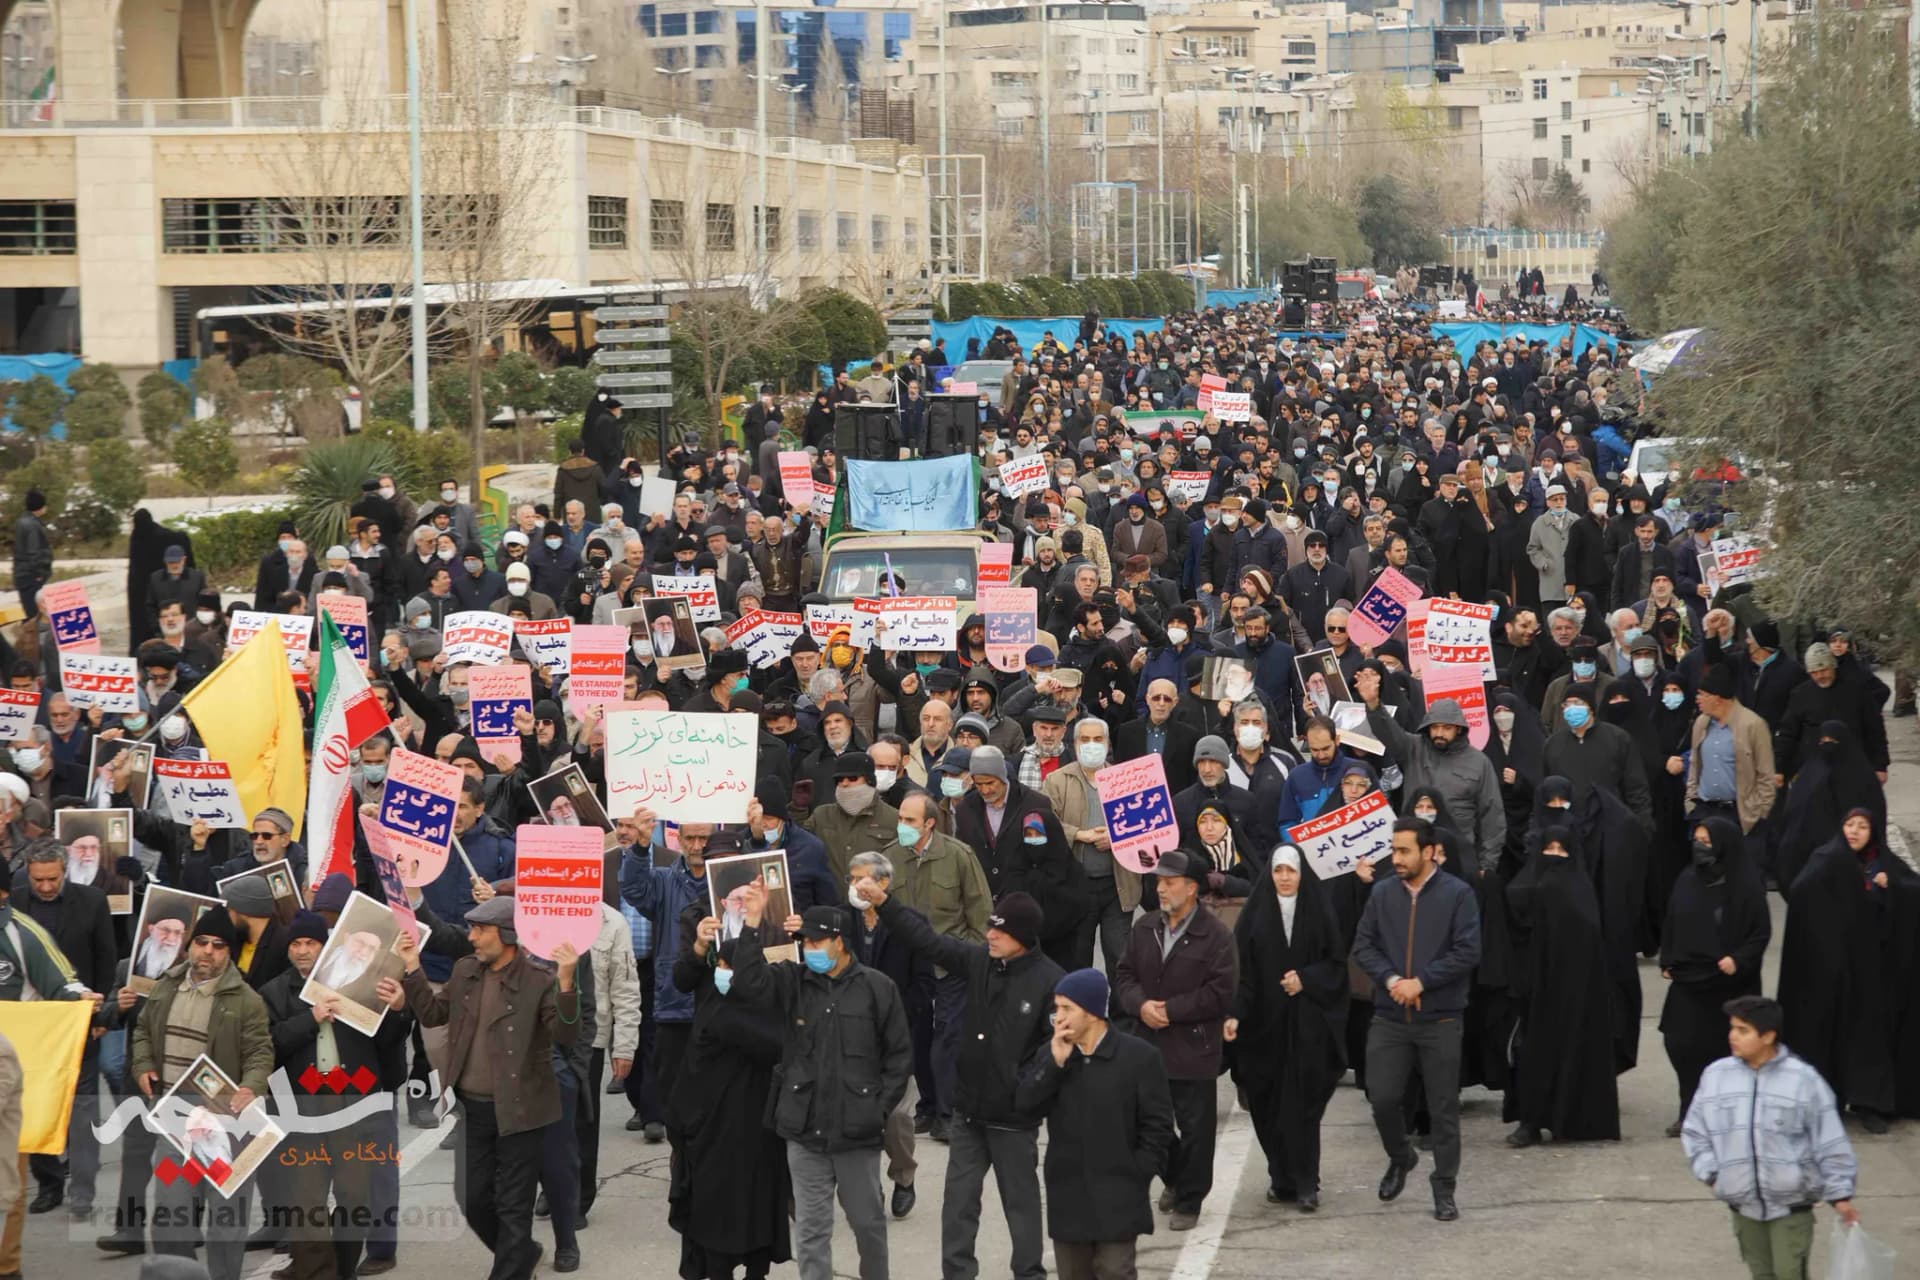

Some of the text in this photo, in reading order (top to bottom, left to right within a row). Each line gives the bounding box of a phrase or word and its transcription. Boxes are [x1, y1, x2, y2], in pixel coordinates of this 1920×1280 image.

[657, 578, 678, 591] آمریکا
[691, 580, 711, 591] مرگ
[696, 593, 716, 604] مرگ
[923, 598, 936, 610] آخر
[889, 613, 950, 630] مطیع امر
[899, 633, 945, 647] رهبریم
[574, 689, 585, 697] TO
[667, 748, 710, 766] است
[697, 768, 748, 799] دشمن
[188, 782, 229, 803] مطیع
[388, 789, 448, 817] مرگ بر
[1112, 792, 1162, 821] مرگ بر
[1361, 801, 1370, 811] تا
[1370, 798, 1380, 806] ما
[1344, 805, 1361, 823] آخر
[385, 805, 447, 840] امریکا
[1112, 807, 1168, 837] امریکا
[1317, 817, 1387, 859] مطیع امر
[569, 865, 591, 882] آخر
[592, 867, 600, 879] تا
[518, 893, 538, 903] WE
[522, 906, 593, 918] TO THE END
